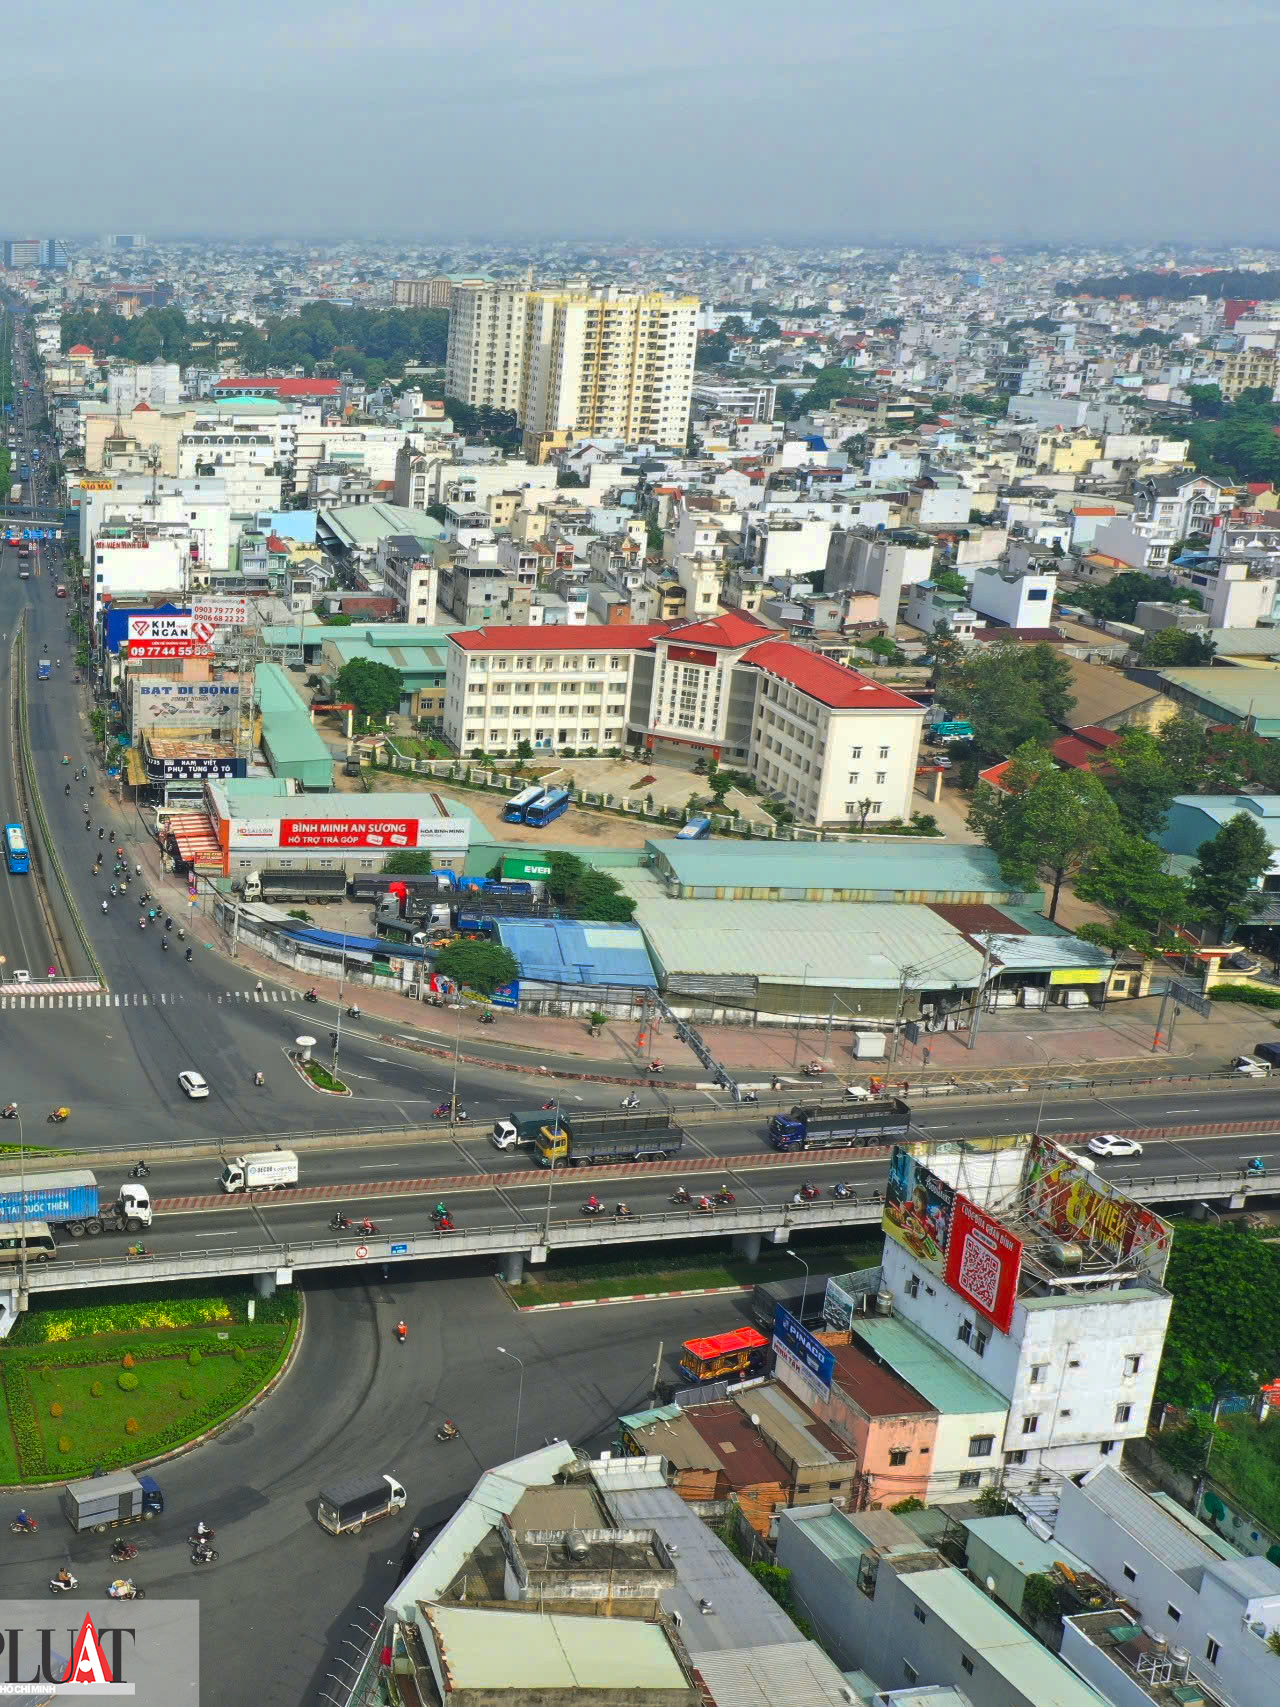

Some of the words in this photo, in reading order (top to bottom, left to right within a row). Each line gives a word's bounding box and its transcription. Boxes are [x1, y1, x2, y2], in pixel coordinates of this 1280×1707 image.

[152, 620, 176, 628] KIM
[131, 646, 145, 656] 09
[147, 647, 160, 656] 77
[161, 646, 176, 656] 44
[178, 646, 192, 655] 55
[140, 686, 172, 696] BẠT
[292, 822, 318, 832] BÌNH
[320, 823, 348, 832] MINH
[350, 823, 366, 832] AN
[340, 835, 359, 843] GÓP
[789, 1325, 825, 1364] PINACO
